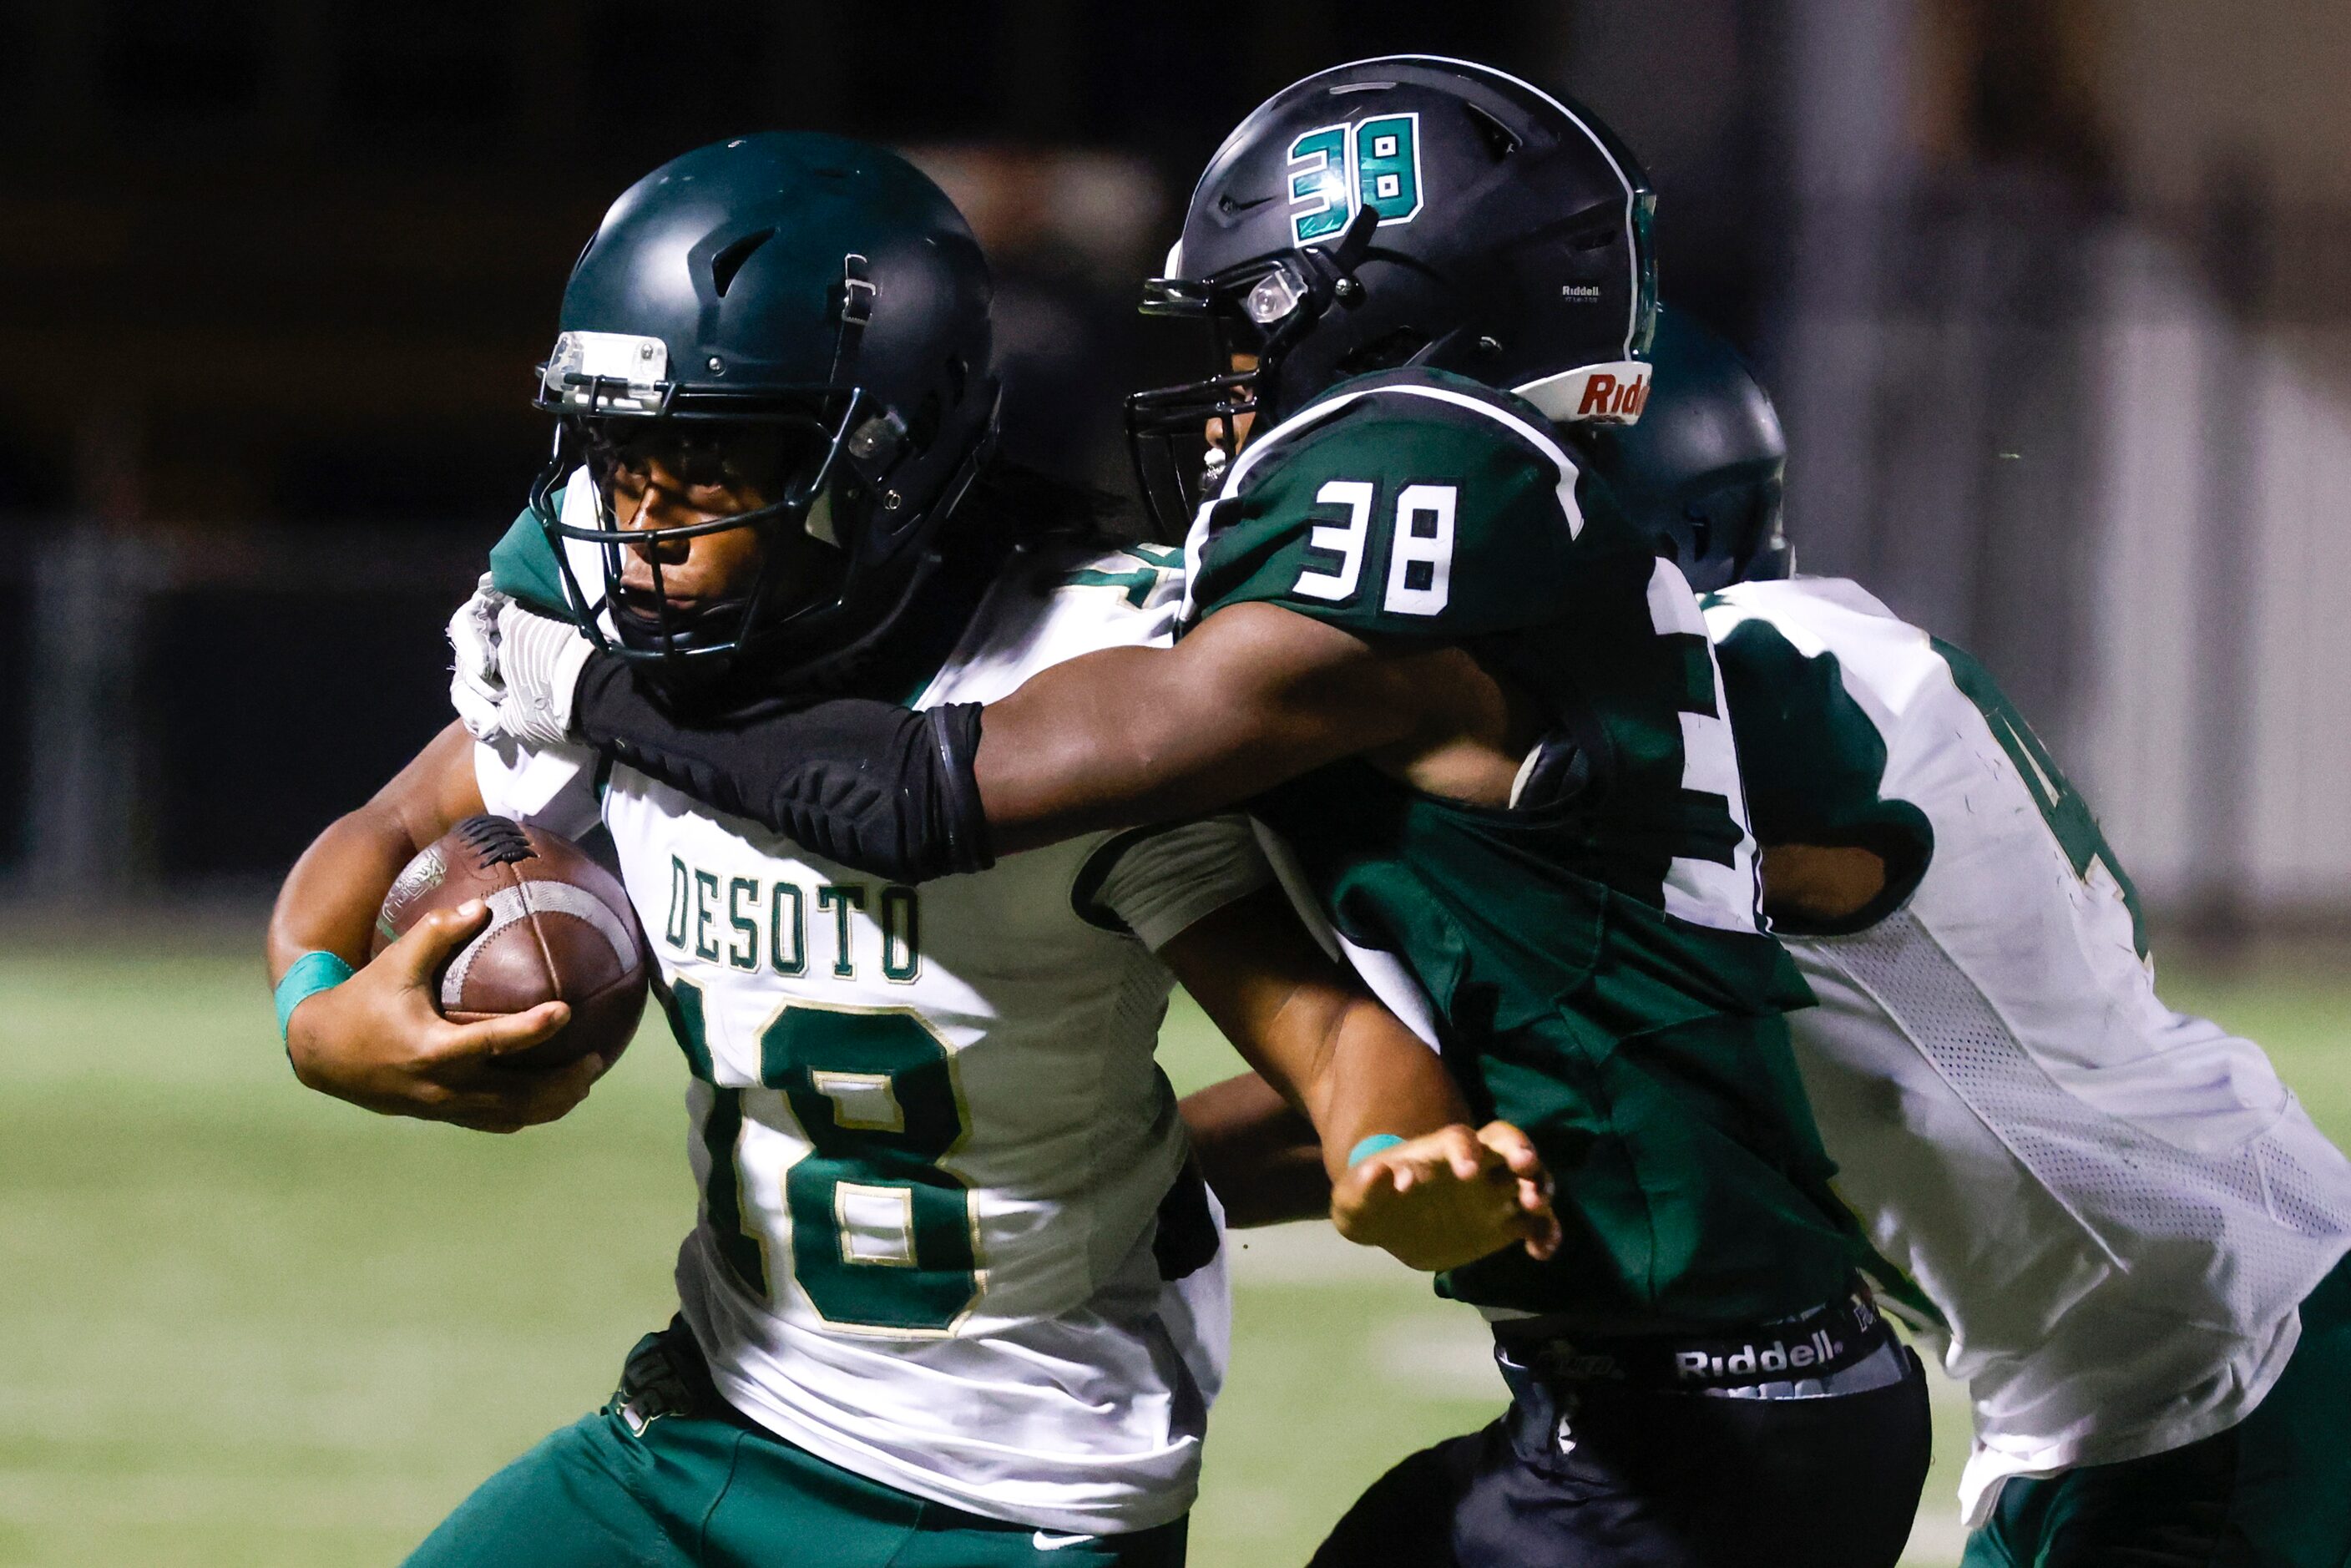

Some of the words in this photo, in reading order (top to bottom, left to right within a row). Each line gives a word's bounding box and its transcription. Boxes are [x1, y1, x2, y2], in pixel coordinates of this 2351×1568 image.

[1287, 112, 1424, 249] 38
[1562, 285, 1600, 296] Riddell
[1292, 480, 1459, 616] 38
[666, 852, 923, 985] DESOTO
[662, 967, 992, 1338] 18
[1675, 1329, 1836, 1381] Riddell
